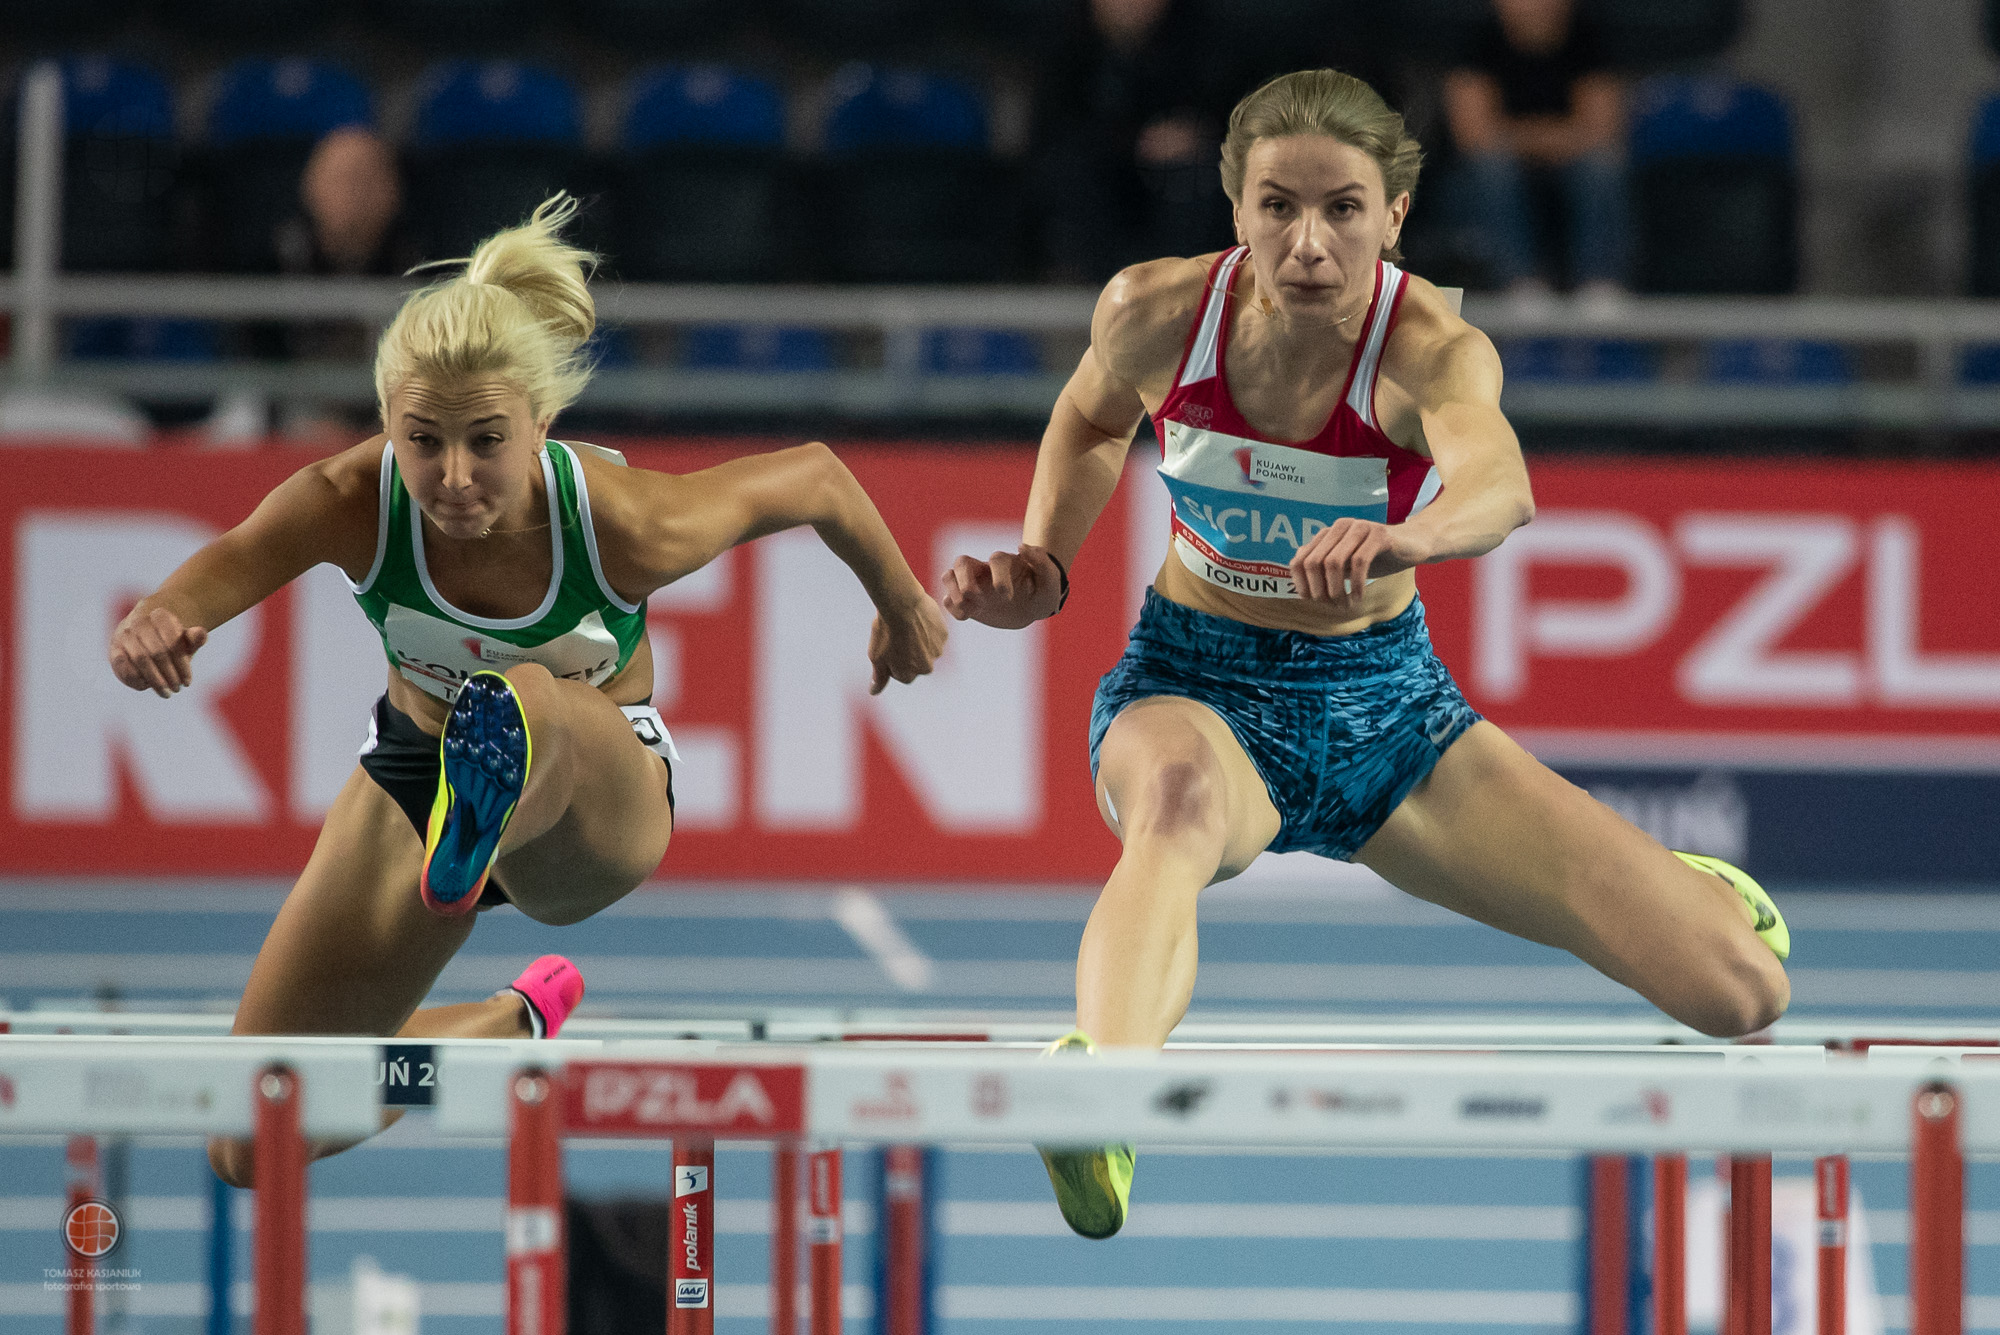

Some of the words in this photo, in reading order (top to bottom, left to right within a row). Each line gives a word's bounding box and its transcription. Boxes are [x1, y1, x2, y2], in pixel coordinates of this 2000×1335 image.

[1256, 459, 1296, 473] KUJAWY
[1255, 469, 1306, 484] POMORZE
[1195, 539, 1215, 560] PZLA
[1215, 555, 1257, 572] HALOWE
[1204, 562, 1278, 593] TORUŃ
[486, 648, 526, 659] KUJAWY
[682, 1202, 701, 1272] polanik
[680, 1287, 704, 1295] IAAF
